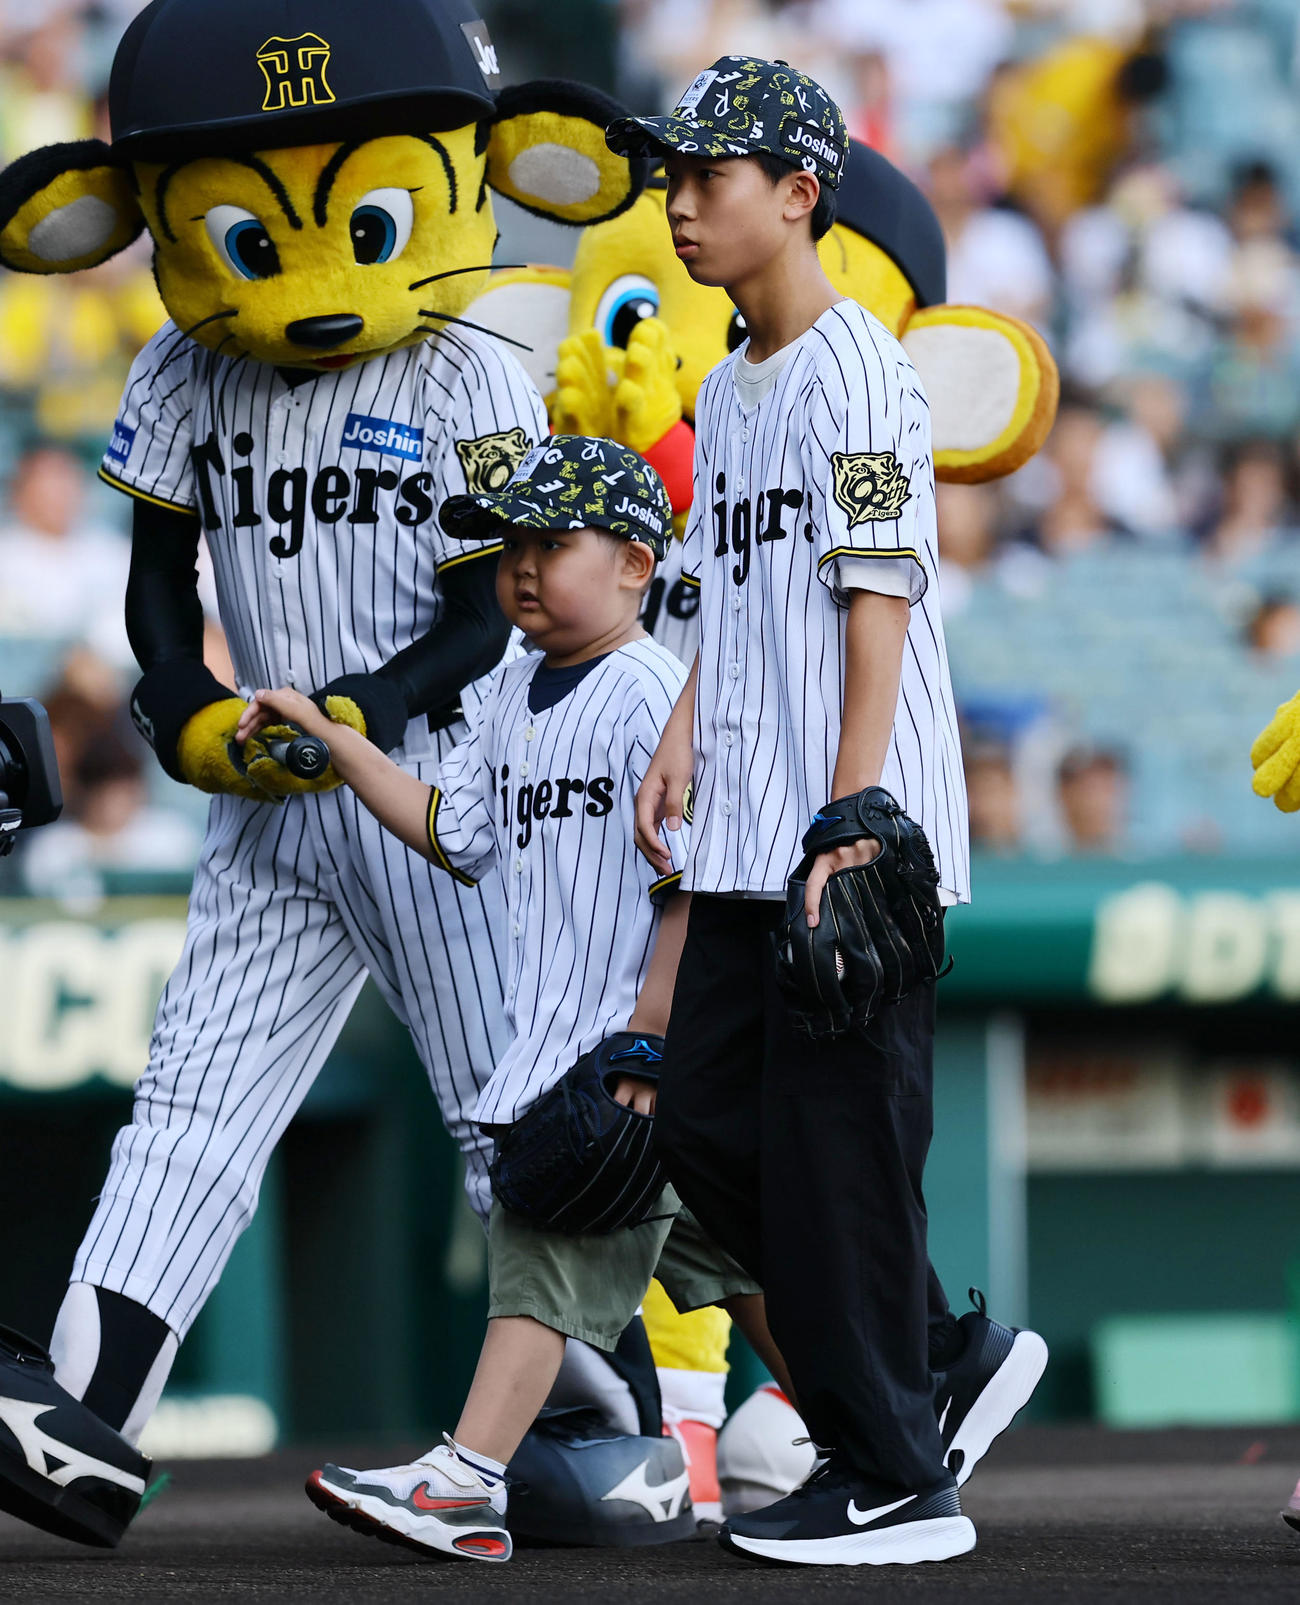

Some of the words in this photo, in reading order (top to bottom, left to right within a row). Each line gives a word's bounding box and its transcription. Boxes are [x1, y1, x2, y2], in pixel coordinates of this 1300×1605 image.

[788, 126, 839, 166] Joshin
[345, 421, 422, 455] Joshin
[190, 431, 434, 558] Tigers
[871, 509, 898, 517] Tigers
[614, 496, 663, 535] Joshin
[491, 763, 615, 850] igers
